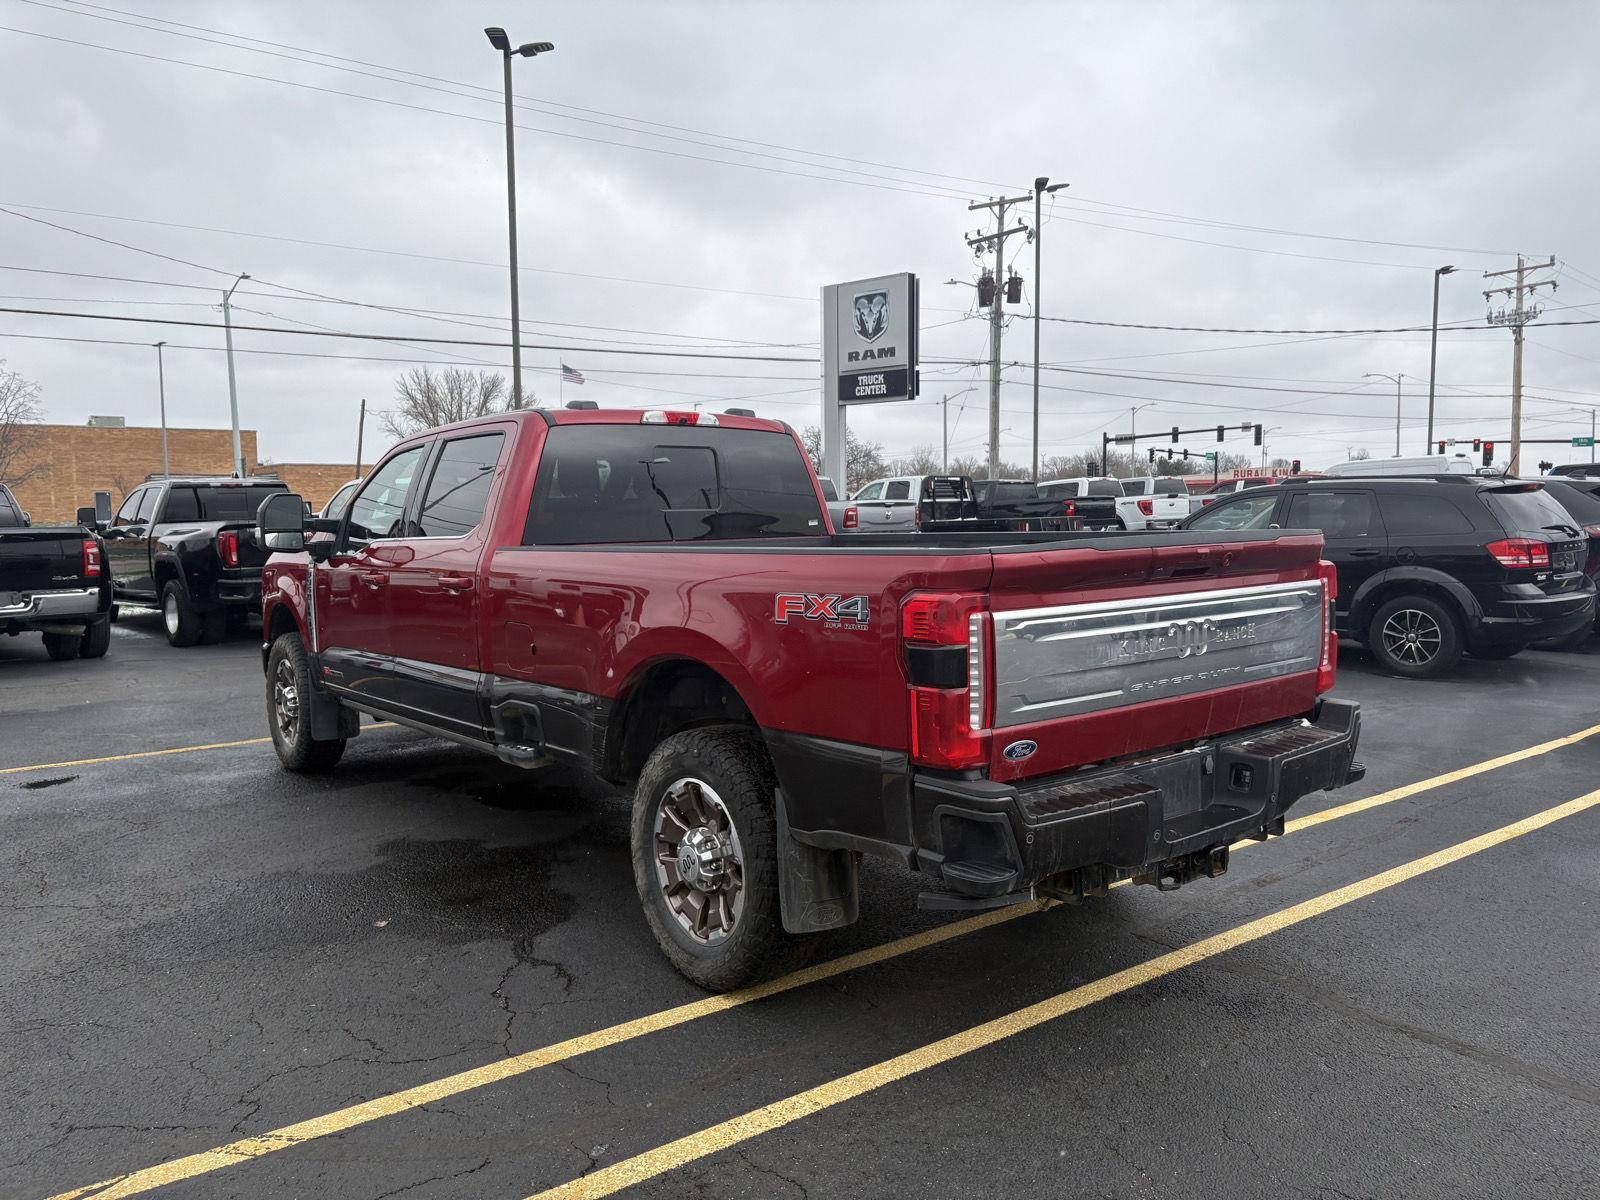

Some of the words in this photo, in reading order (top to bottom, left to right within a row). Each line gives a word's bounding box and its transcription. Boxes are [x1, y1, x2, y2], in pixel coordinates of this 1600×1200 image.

[848, 346, 896, 362] RAM
[855, 384, 887, 396] CENTER
[858, 374, 884, 386] TRUCK
[775, 592, 870, 624] FX4
[1119, 637, 1166, 657] KING
[1216, 622, 1256, 643] RANCH
[1130, 674, 1194, 692] SUPER
[1198, 666, 1241, 679] DUTY
